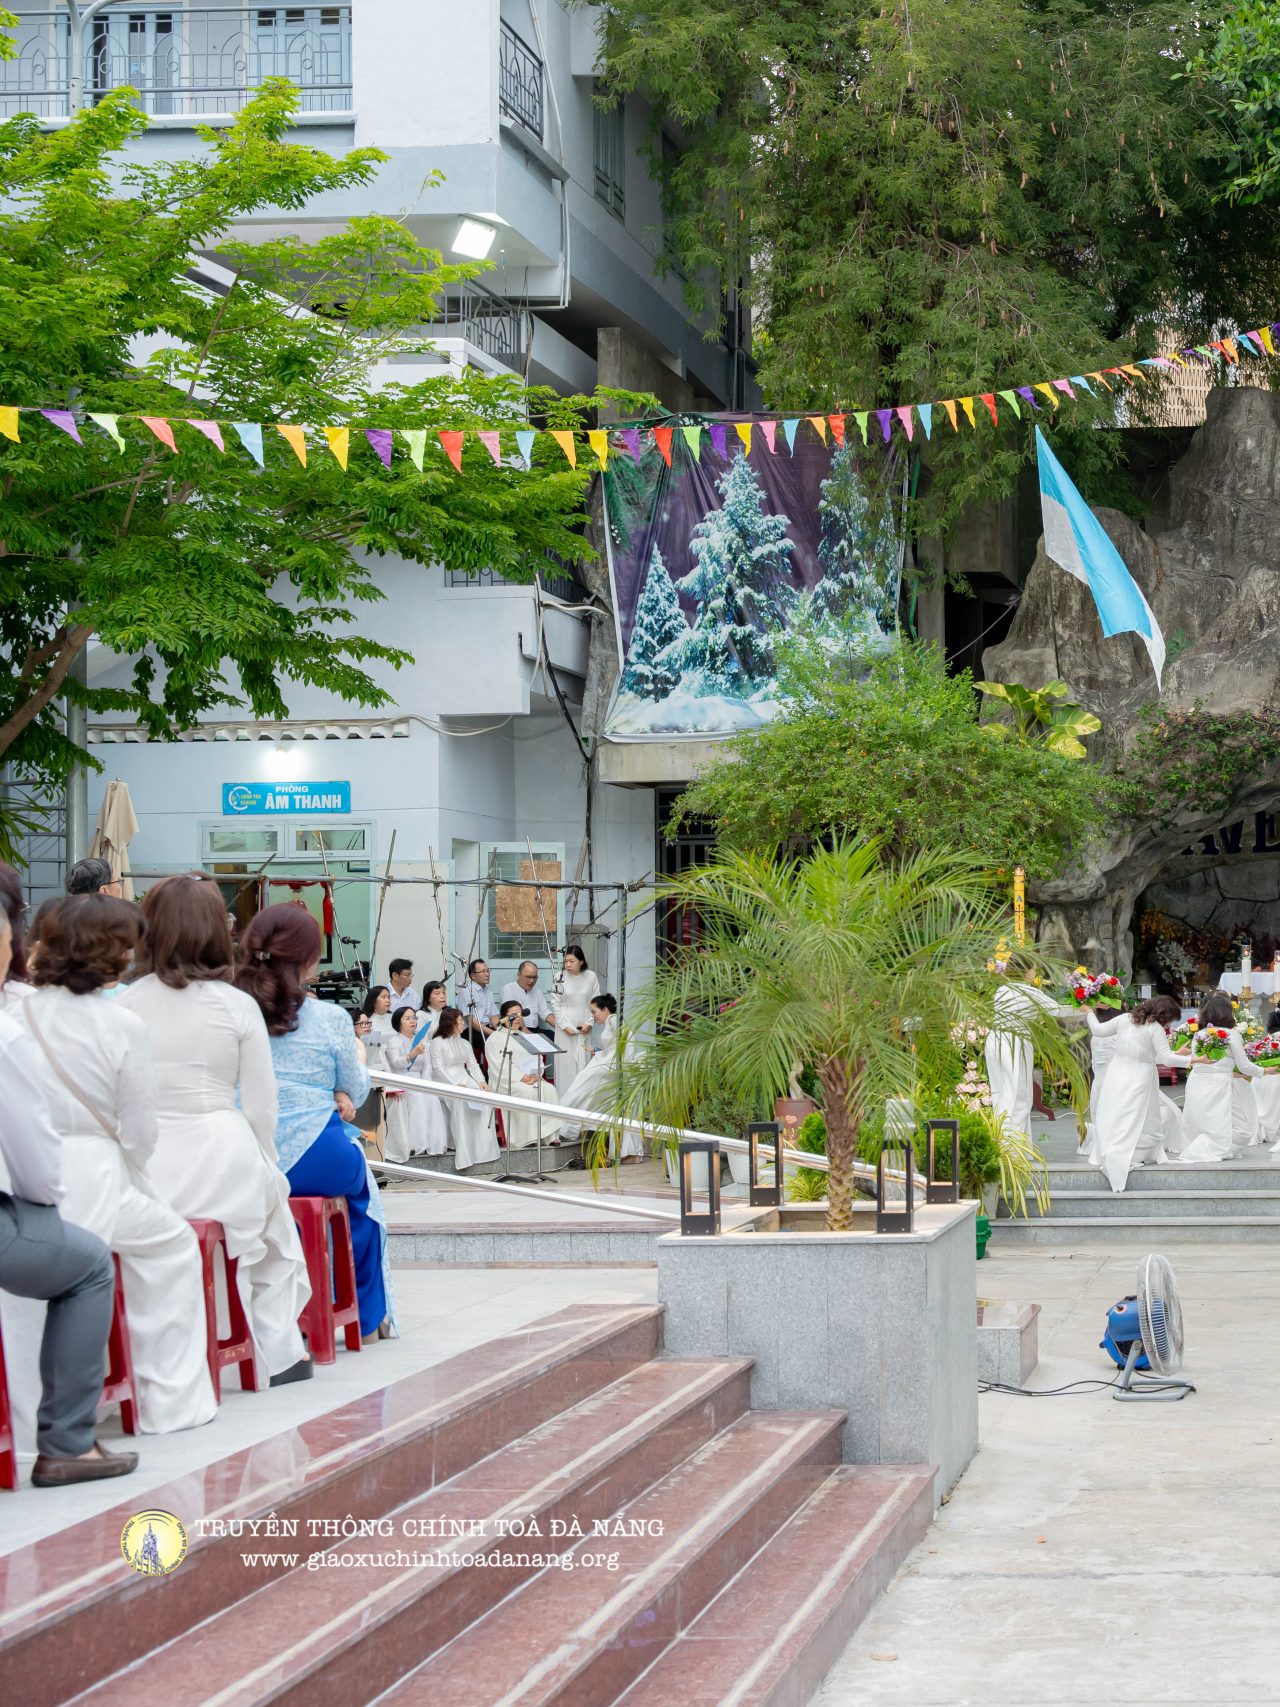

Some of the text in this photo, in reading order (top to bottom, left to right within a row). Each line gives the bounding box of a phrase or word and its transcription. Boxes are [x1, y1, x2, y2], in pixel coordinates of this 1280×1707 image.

[275, 784, 309, 793] PHÒNG
[264, 792, 342, 810] ÂM THANH
